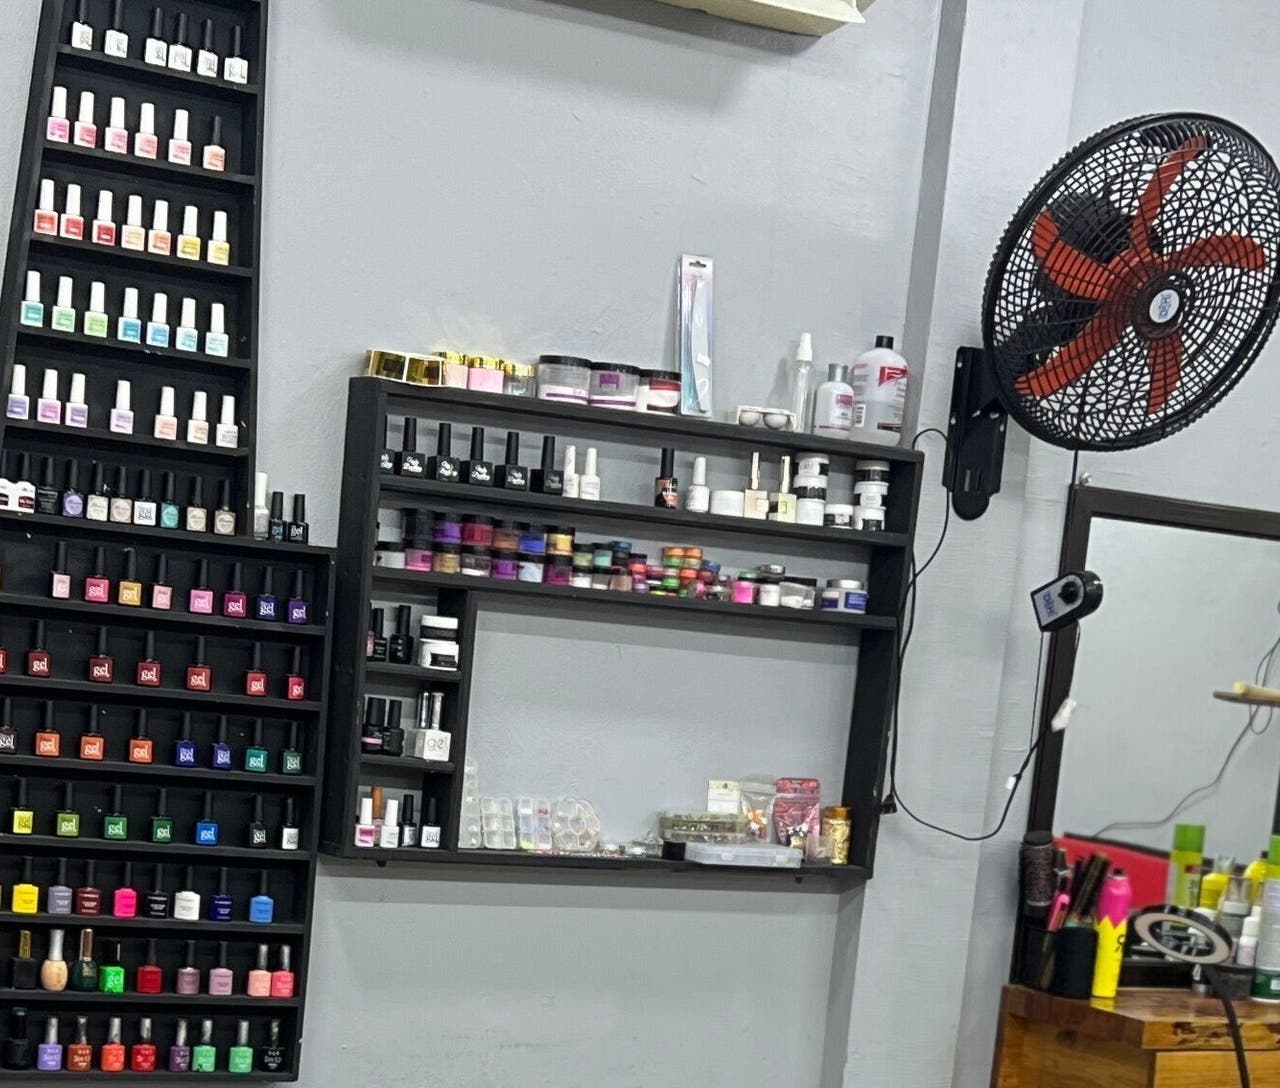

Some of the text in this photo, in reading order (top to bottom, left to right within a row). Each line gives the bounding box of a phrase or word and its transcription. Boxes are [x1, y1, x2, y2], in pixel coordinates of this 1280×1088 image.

[88, 584, 105, 598] gel
[228, 599, 243, 613] gel
[293, 606, 307, 619] gel
[32, 658, 48, 672] gel
[93, 664, 110, 678] gel
[141, 667, 157, 681] gel
[190, 673, 207, 687] gel
[250, 678, 264, 692] gel
[0, 735, 15, 749] gel
[39, 739, 57, 752] gel
[84, 742, 100, 755] gel
[427, 735, 449, 751] gel
[133, 745, 149, 759] gel
[249, 755, 264, 769] gel
[61, 819, 77, 833] gel
[107, 821, 124, 835] gel
[156, 826, 171, 838] gel
[200, 827, 216, 841] gel
